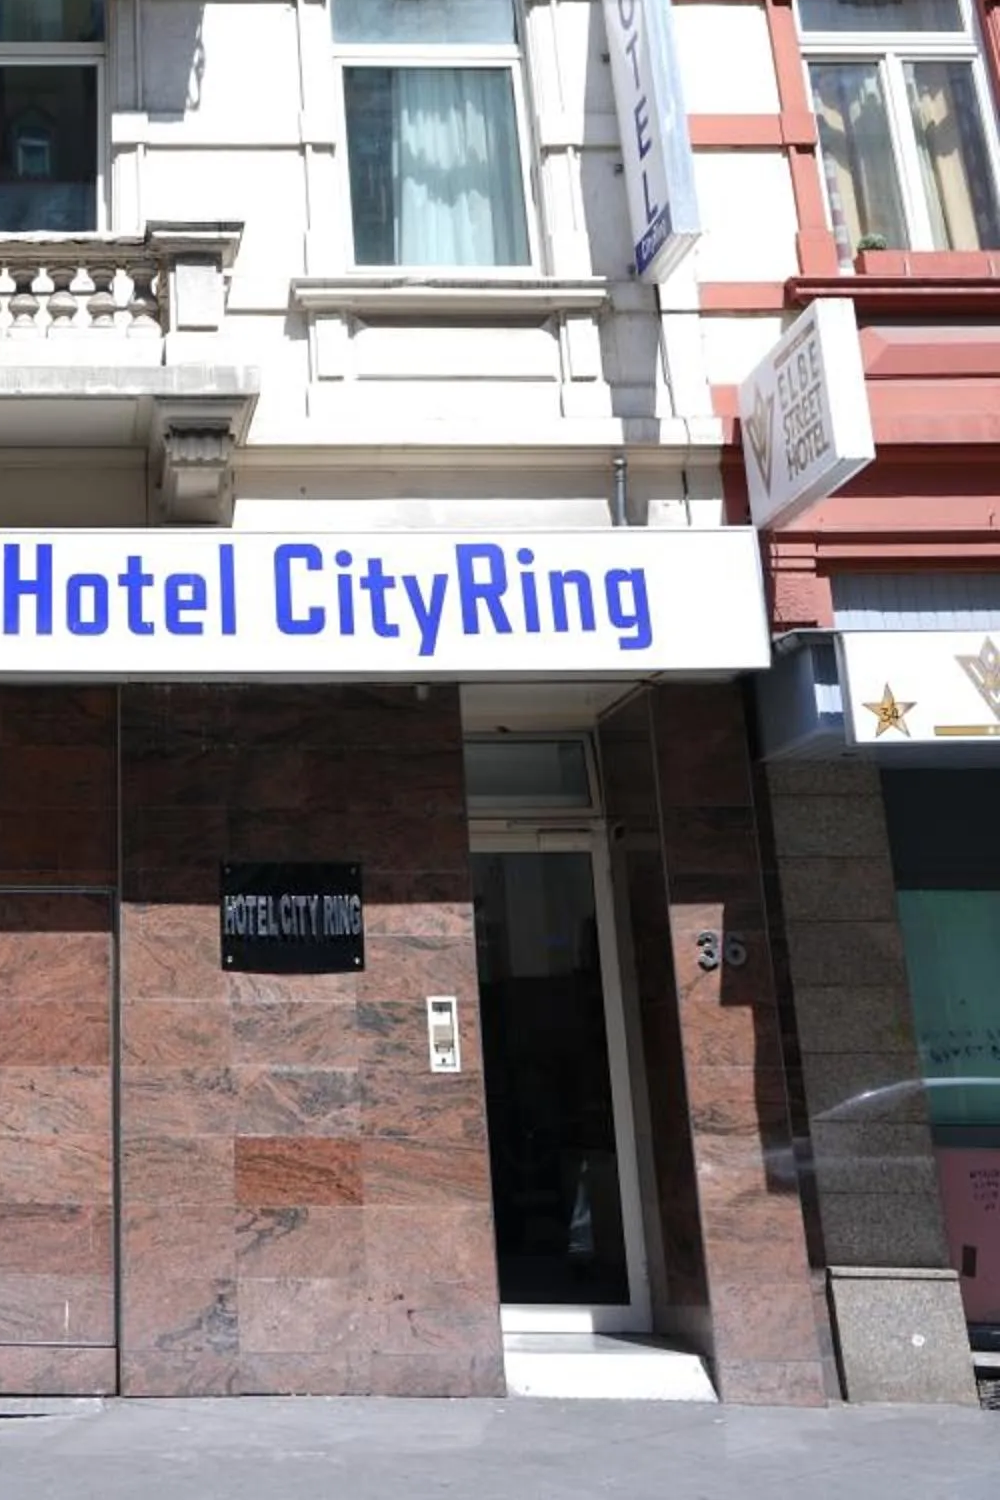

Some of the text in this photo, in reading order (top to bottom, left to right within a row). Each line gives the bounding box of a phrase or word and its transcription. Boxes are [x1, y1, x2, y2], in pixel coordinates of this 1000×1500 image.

[777, 339, 820, 410] ELBE
[783, 381, 822, 445] STREET
[786, 420, 830, 481] HOTEL
[2, 543, 653, 656] Hotel CityRing
[880, 707, 900, 723] 34
[224, 894, 362, 936] HOTEL CITY RING
[697, 930, 747, 972] 36
